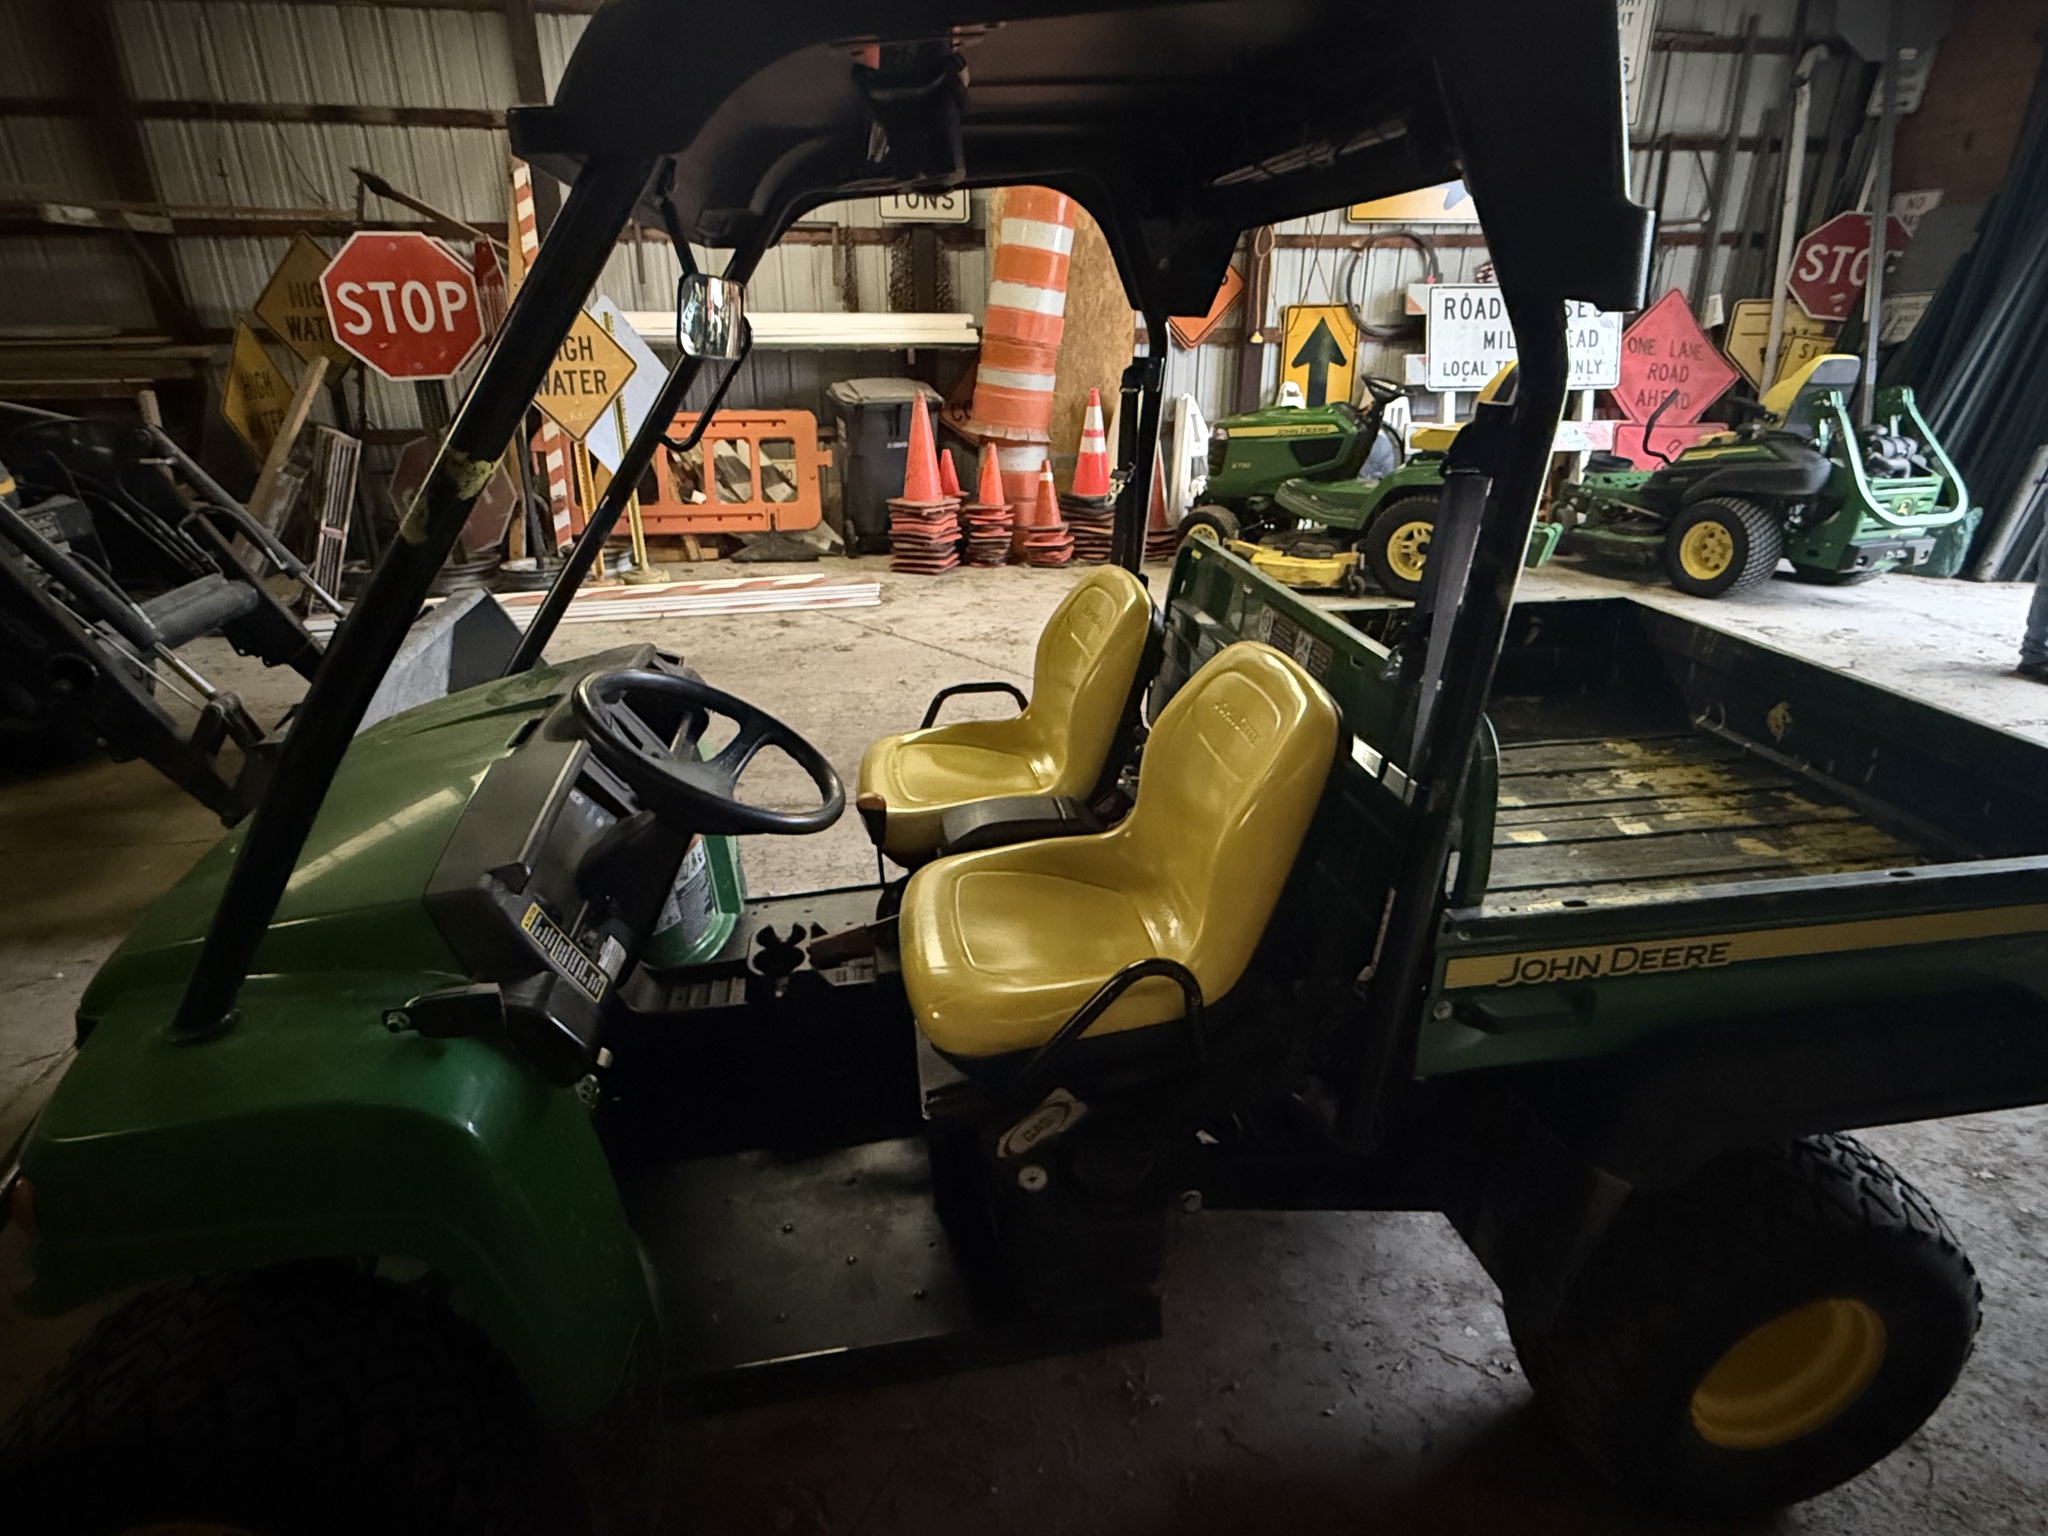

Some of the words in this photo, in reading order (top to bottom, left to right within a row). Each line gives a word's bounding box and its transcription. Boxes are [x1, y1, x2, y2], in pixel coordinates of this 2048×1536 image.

[1799, 243, 1903, 287] STO
[288, 281, 325, 308] HIG
[336, 280, 467, 335] STOP
[1443, 297, 1501, 320] ROAD
[284, 316, 326, 342] WAT
[1483, 331, 1517, 349] MIL
[1569, 329, 1599, 348] EAD
[556, 335, 594, 362] IGH
[1627, 336, 1656, 356] ONE
[1669, 339, 1703, 361] LANE
[1443, 360, 1488, 376] LOCAL
[1570, 359, 1602, 375] NLY
[1647, 362, 1690, 383] ROAD
[1496, 953, 1601, 985] JOHN
[1609, 941, 1732, 974] DEERE
[1023, 1116, 1054, 1142] GAS
